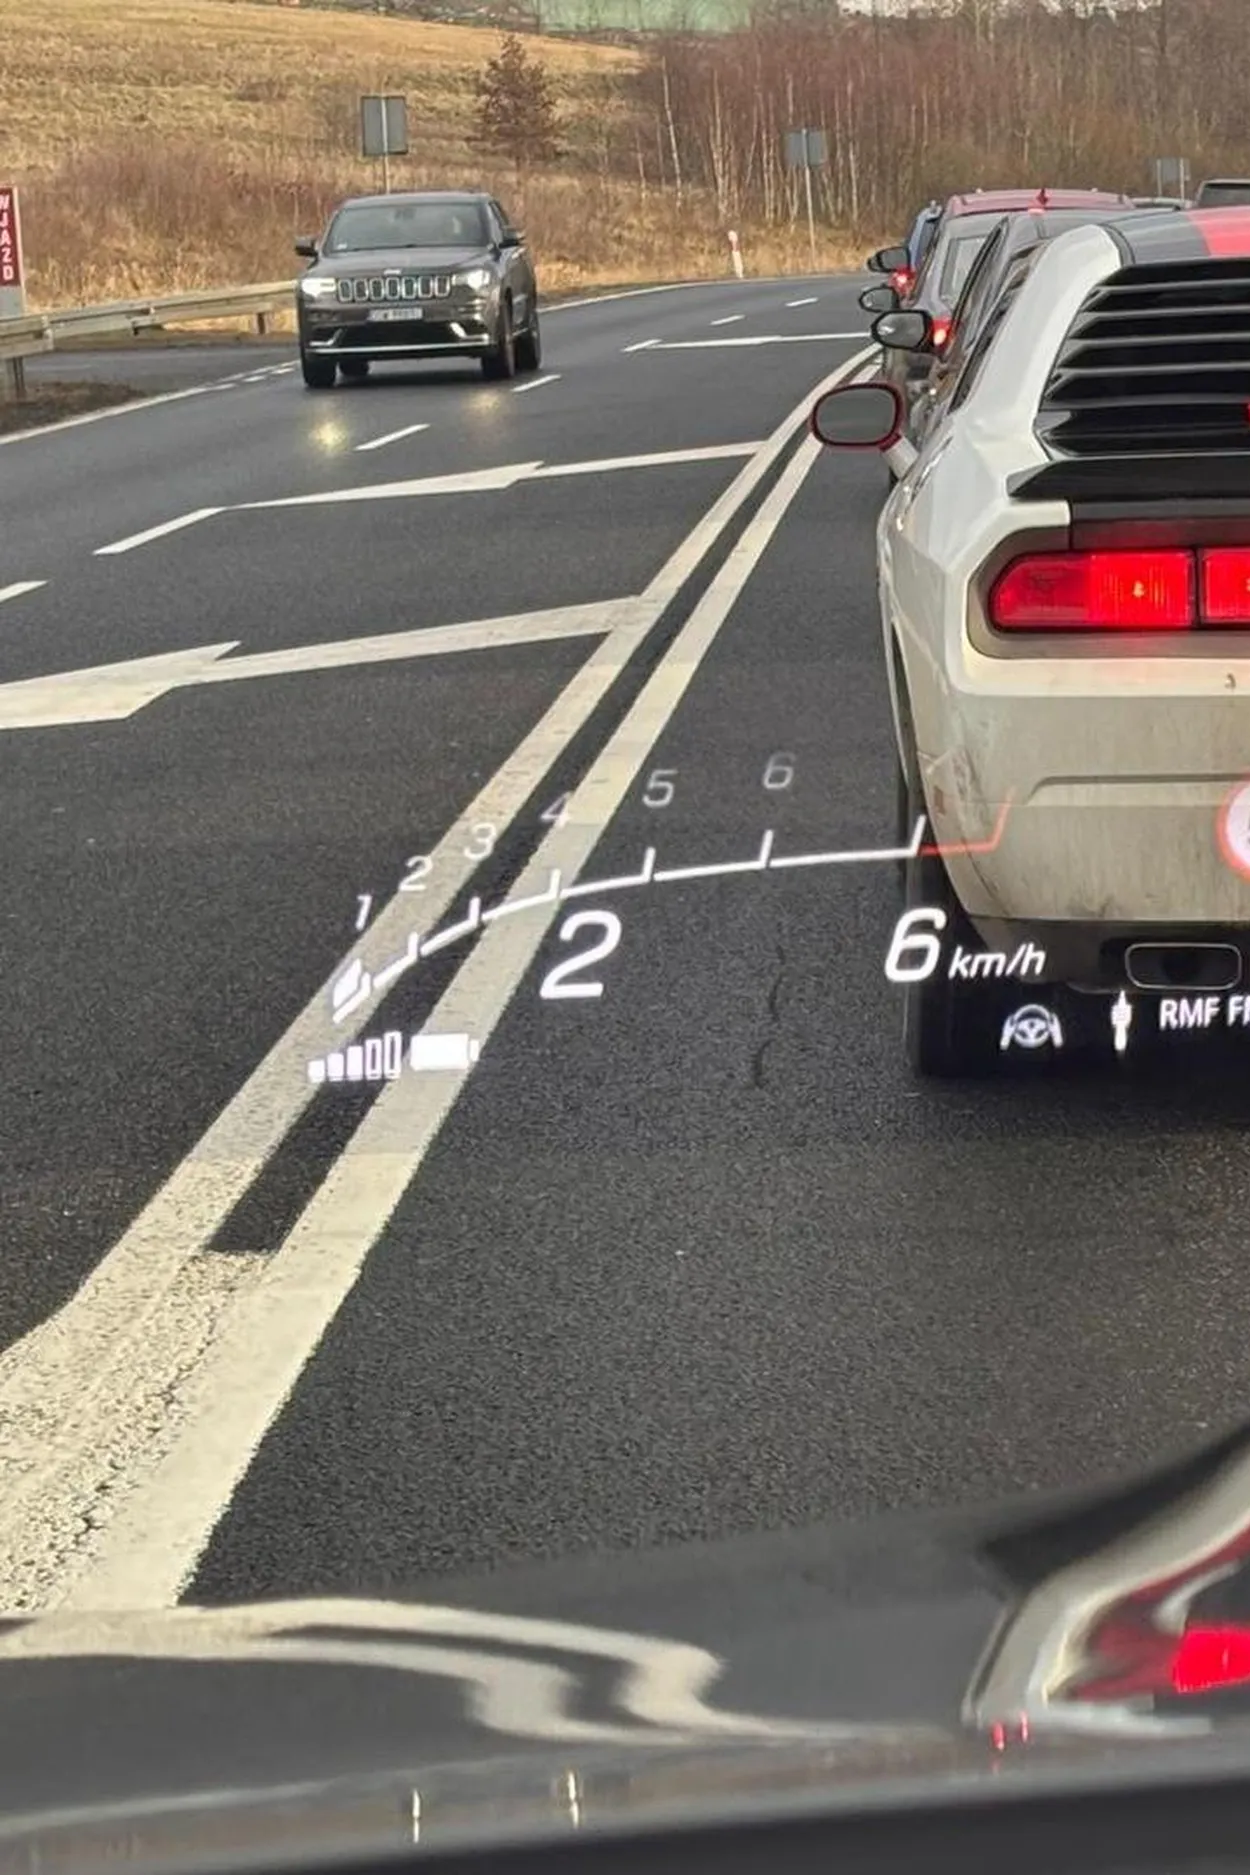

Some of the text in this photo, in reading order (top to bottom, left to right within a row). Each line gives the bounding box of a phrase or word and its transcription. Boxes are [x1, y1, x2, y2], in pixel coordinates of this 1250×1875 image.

[355, 752, 796, 931] 1 2 3 4 5 6
[538, 910, 622, 1000] 2
[884, 908, 1046, 983] 6 km/h
[1159, 997, 1220, 1030] RMF
